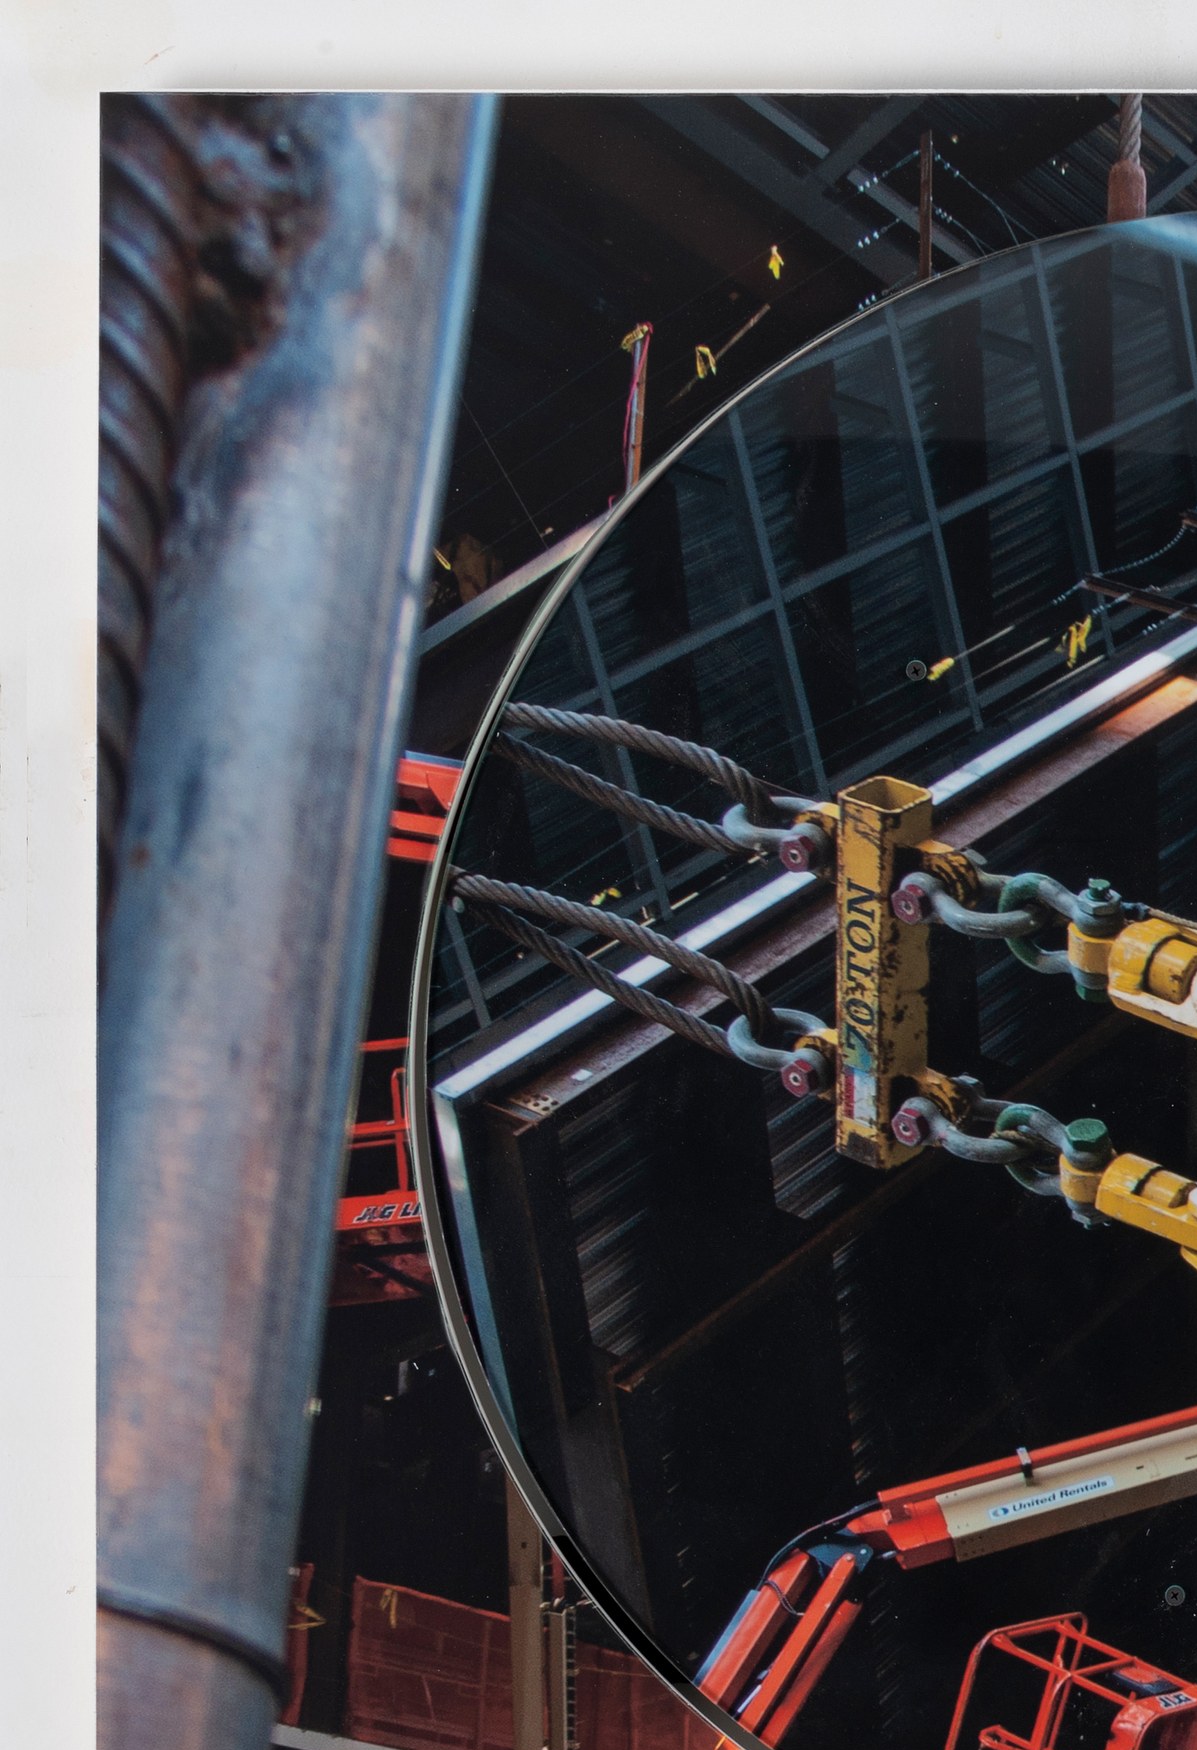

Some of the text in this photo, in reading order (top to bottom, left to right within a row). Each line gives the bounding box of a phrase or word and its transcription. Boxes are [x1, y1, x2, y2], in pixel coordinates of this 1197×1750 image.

[846, 877, 875, 982] TON
[1012, 1479, 1108, 1513] United Rentals
